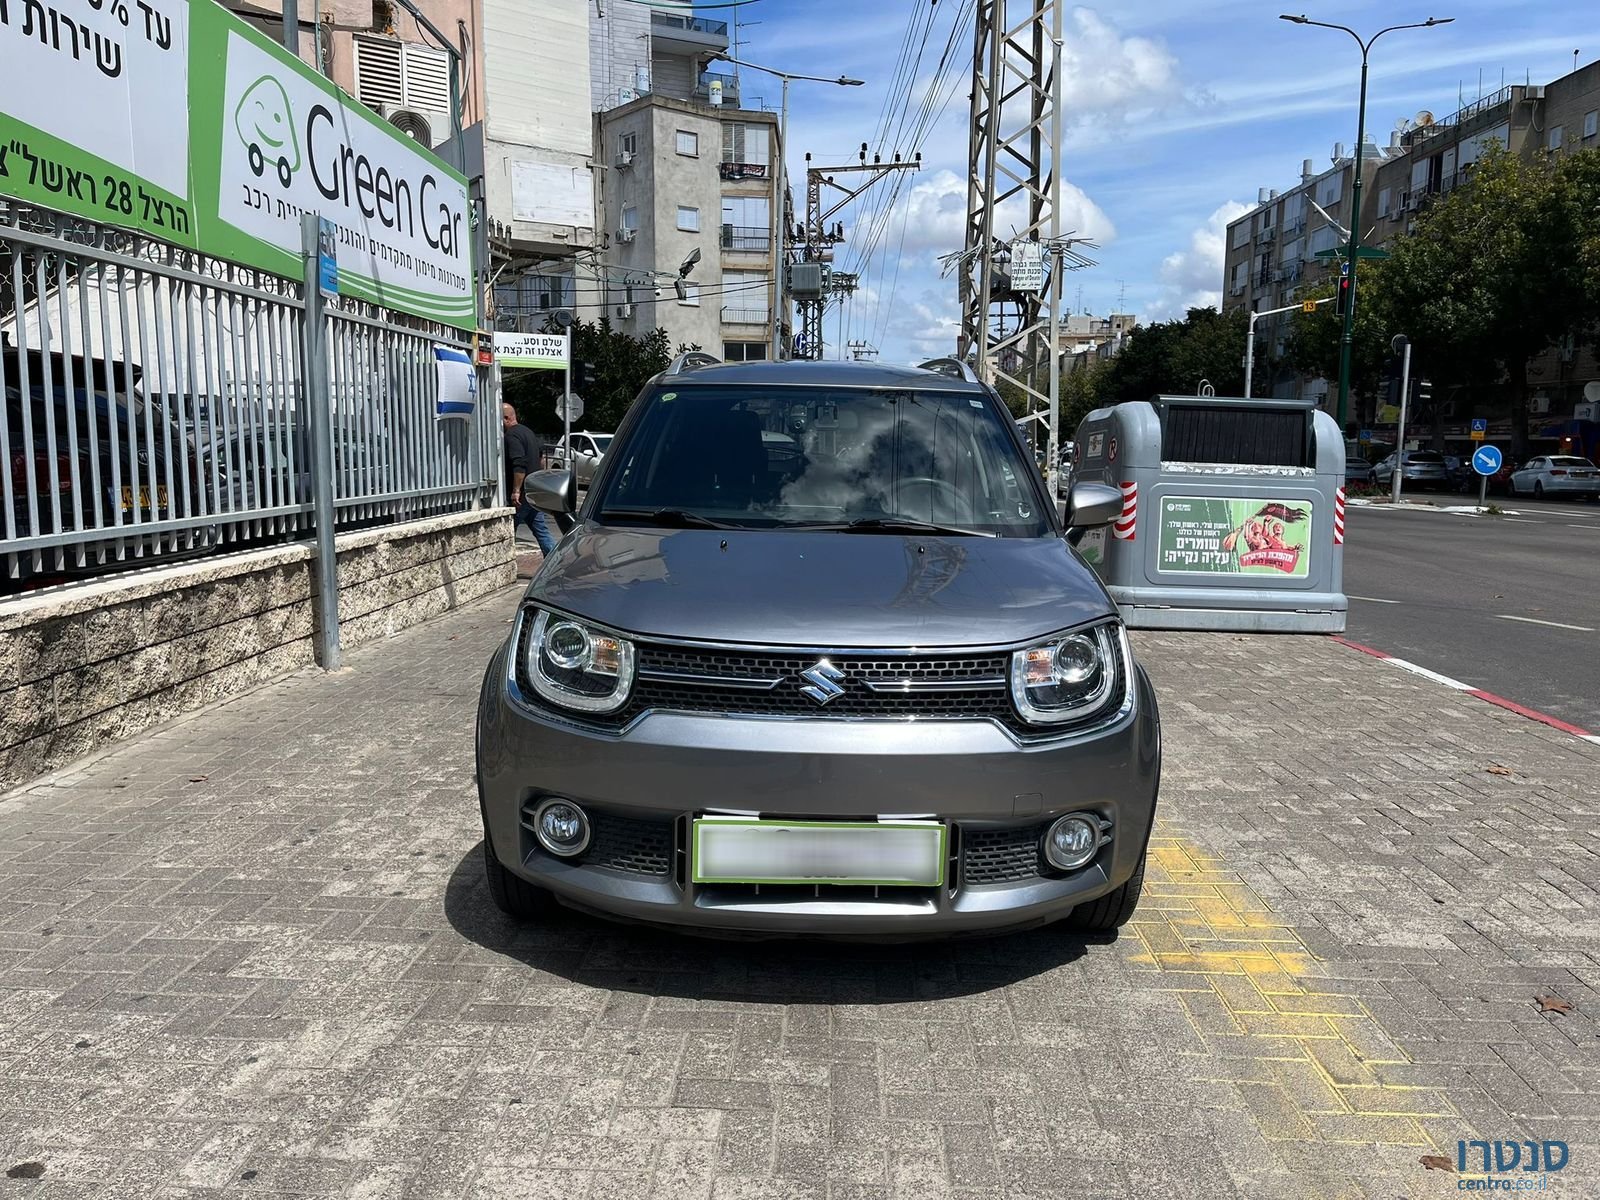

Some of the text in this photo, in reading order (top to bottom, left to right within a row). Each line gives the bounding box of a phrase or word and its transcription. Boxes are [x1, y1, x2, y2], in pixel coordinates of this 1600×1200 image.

[137, 0, 171, 50] עד
[22, 0, 121, 78] שירות
[306, 104, 462, 259] Green Car
[104, 176, 132, 215] 28
[242, 184, 271, 214] רכב
[138, 185, 189, 234] הרצל
[334, 223, 366, 252] והוגני
[369, 238, 412, 270] מתקדמים
[415, 257, 436, 277] מימון
[438, 268, 466, 291] פתרונות
[1305, 302, 1314, 310] 13
[503, 346, 522, 356] קצת
[514, 337, 562, 347] שלם וסע...
[525, 347, 535, 355] זה
[538, 346, 562, 356] אצלנו
[1176, 537, 1220, 550] שומרים
[1164, 550, 1230, 565] עליה נקייה!
